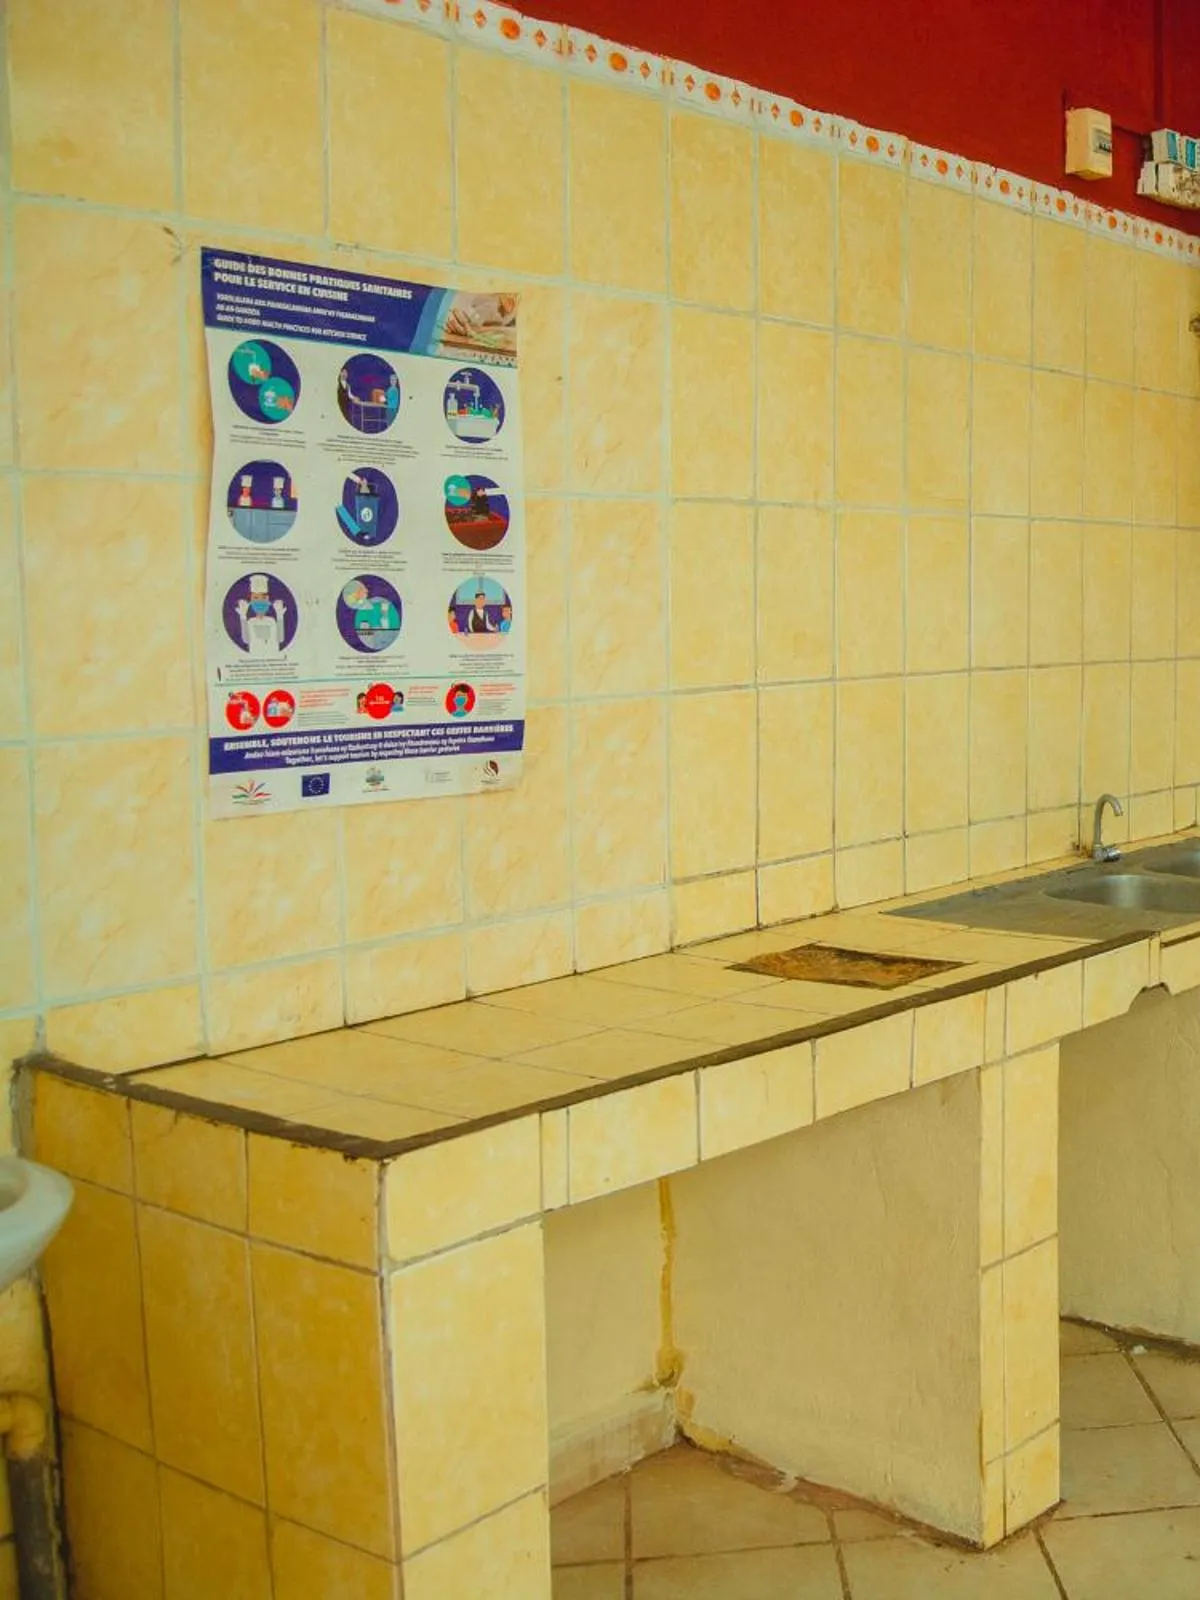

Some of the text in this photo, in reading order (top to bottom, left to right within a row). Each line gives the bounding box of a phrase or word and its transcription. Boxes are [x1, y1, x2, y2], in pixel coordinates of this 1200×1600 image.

[214, 258, 413, 299] GUIDE DES BONNES PRATIQUES SANITAIRES
[214, 272, 348, 302] POUR LE SERVICE EN CUISINE
[224, 739, 270, 751] ENSEMBLE,
[271, 735, 321, 747] SOUTENONS
[323, 734, 333, 744] LE
[334, 732, 371, 743] TOURISME
[372, 731, 383, 739] EN
[384, 728, 430, 739] RESPECTANT
[431, 727, 445, 736] CES
[446, 726, 473, 735] GESTES
